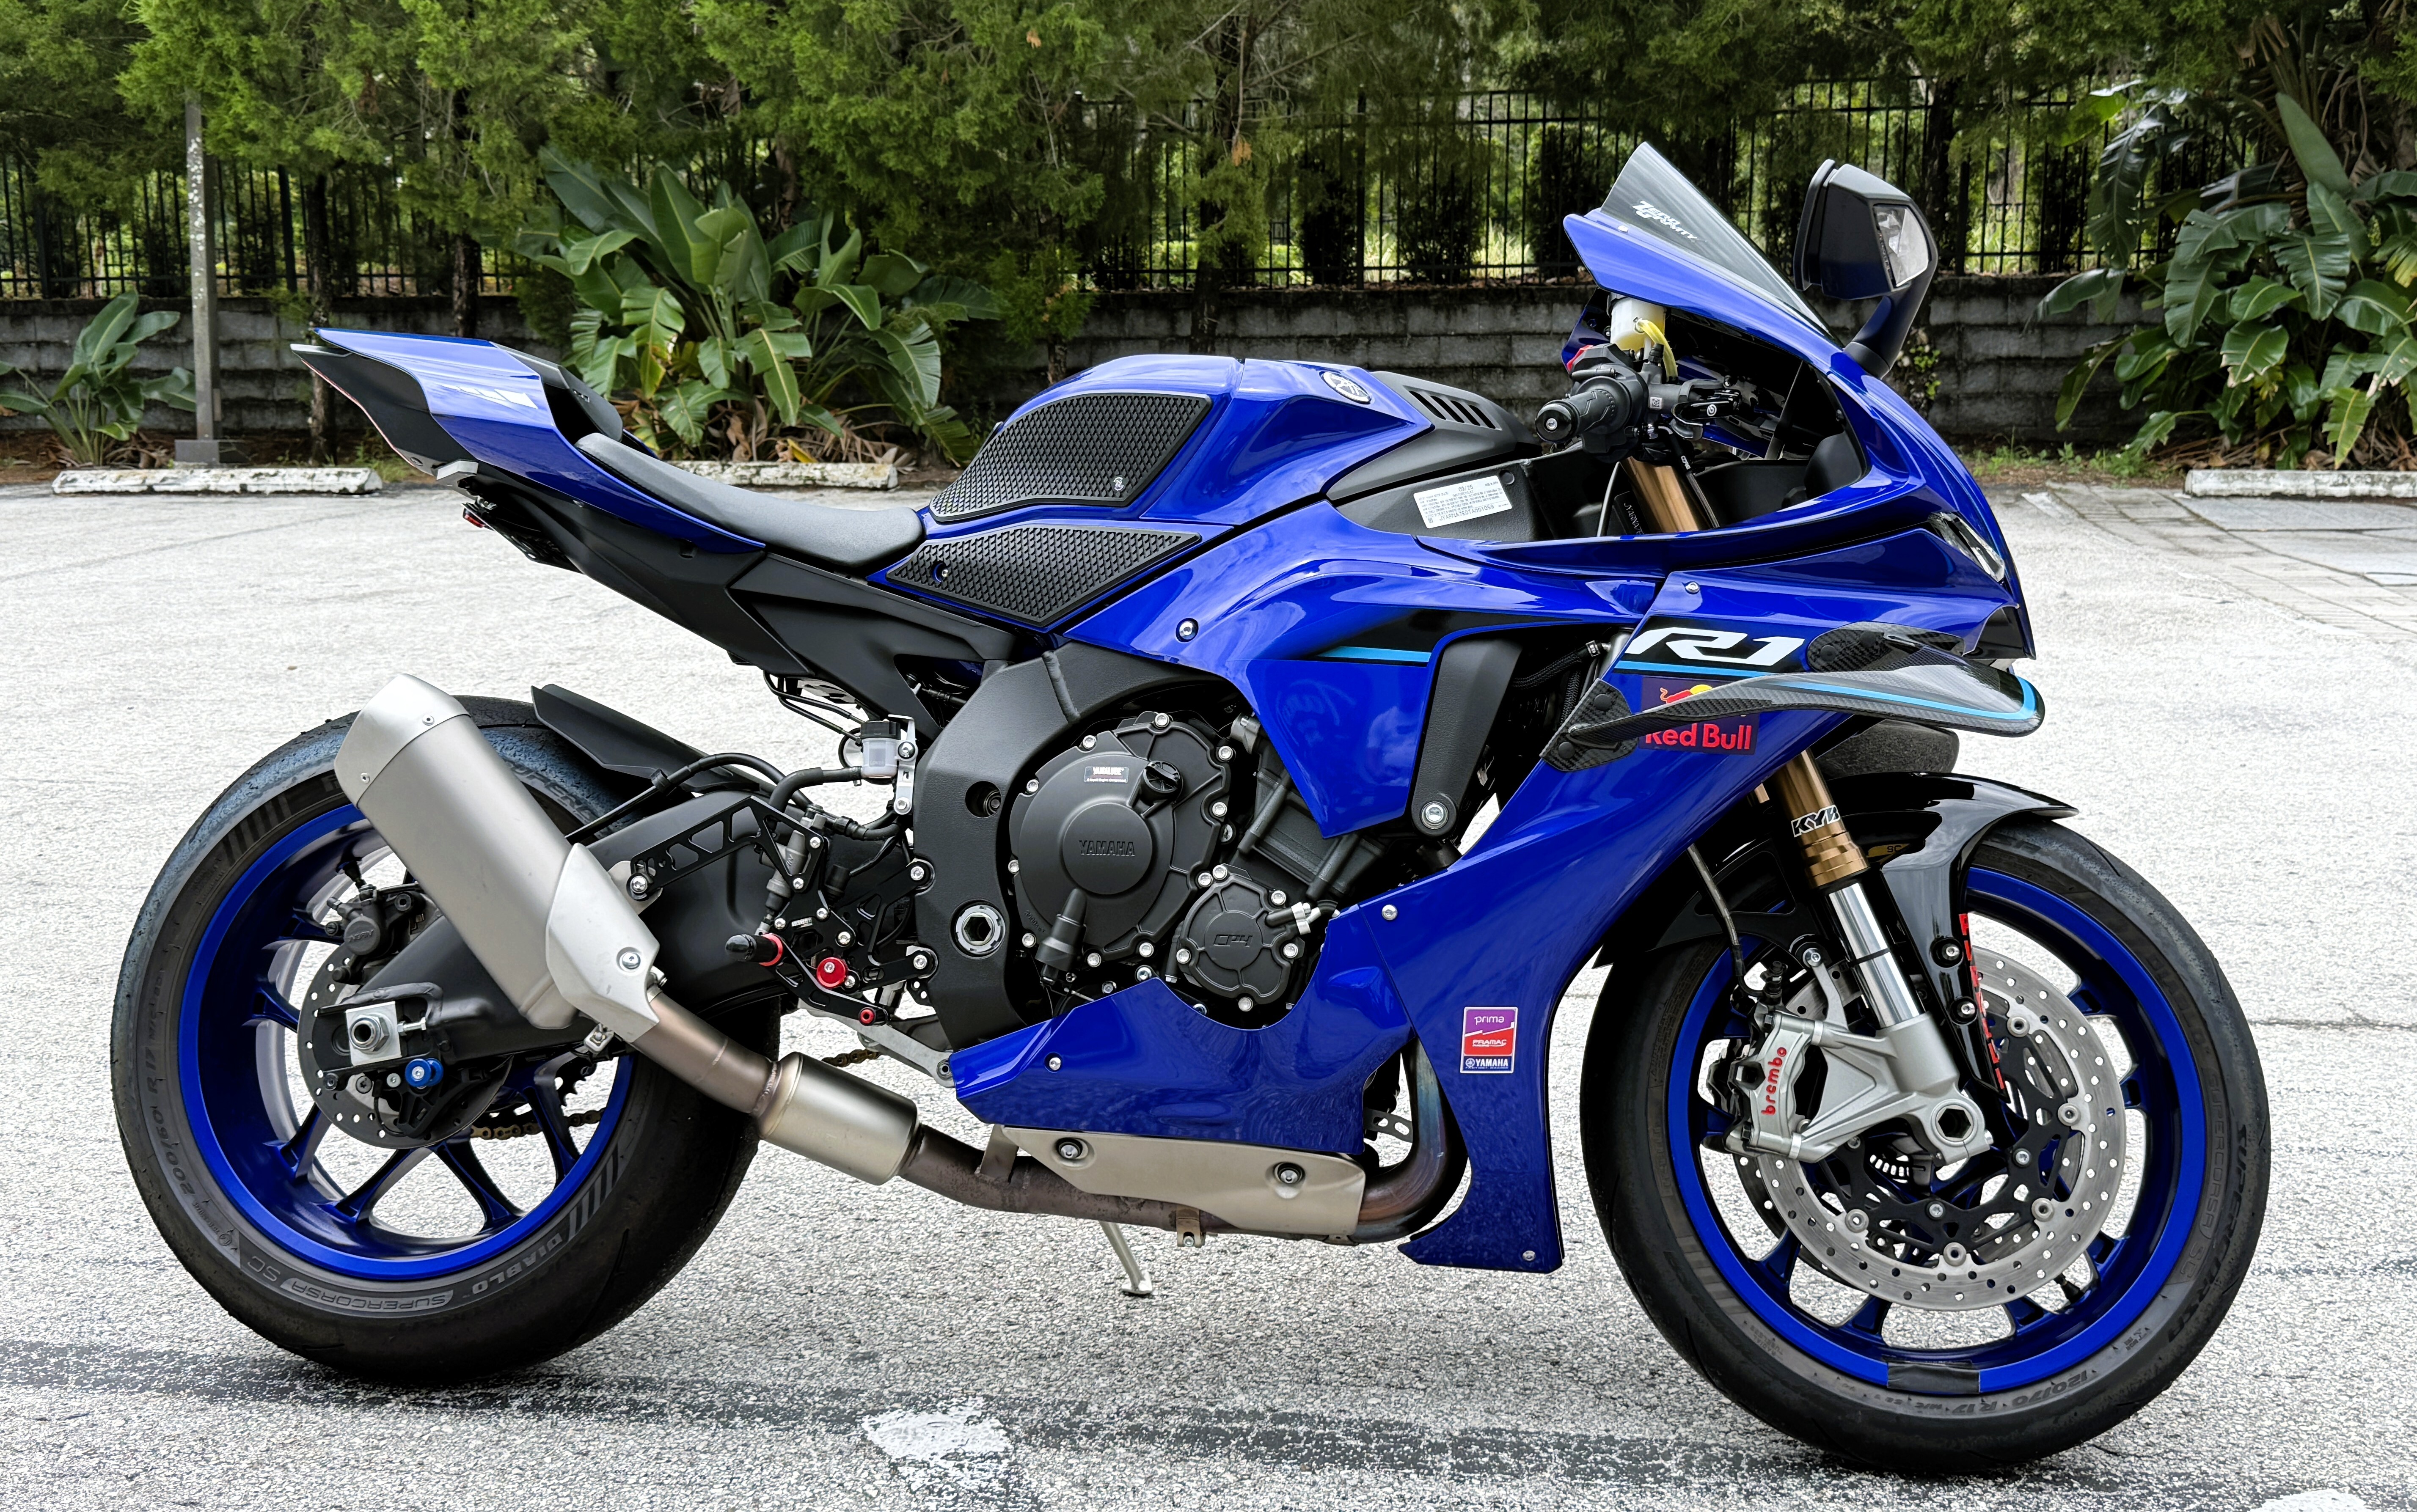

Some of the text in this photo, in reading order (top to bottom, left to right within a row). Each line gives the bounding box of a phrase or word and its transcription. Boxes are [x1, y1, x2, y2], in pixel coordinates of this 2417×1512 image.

[1632, 201, 1680, 225] ZERO
[1624, 627, 1805, 666] R1
[1645, 722, 1752, 750] Red Bull
[1791, 804, 1841, 838] KYB
[1079, 840, 1135, 856] YAMAHA
[1213, 934, 1253, 947] CP4
[1474, 1016, 1505, 1025] prima
[1476, 1058, 1508, 1067] YAMAHA
[1761, 1047, 1787, 1115] brembo
[151, 1108, 195, 1199] 200/60
[2202, 1073, 2224, 1229] SUPERCORSA
[2162, 1121, 2246, 1343] SUPERCORSA
[246, 1232, 564, 1310] DIABLO SUPERCORSA SC
[2011, 1370, 2090, 1407] 120/70
[1951, 1403, 1977, 1413] 17
[1978, 1399, 1999, 1413] R
